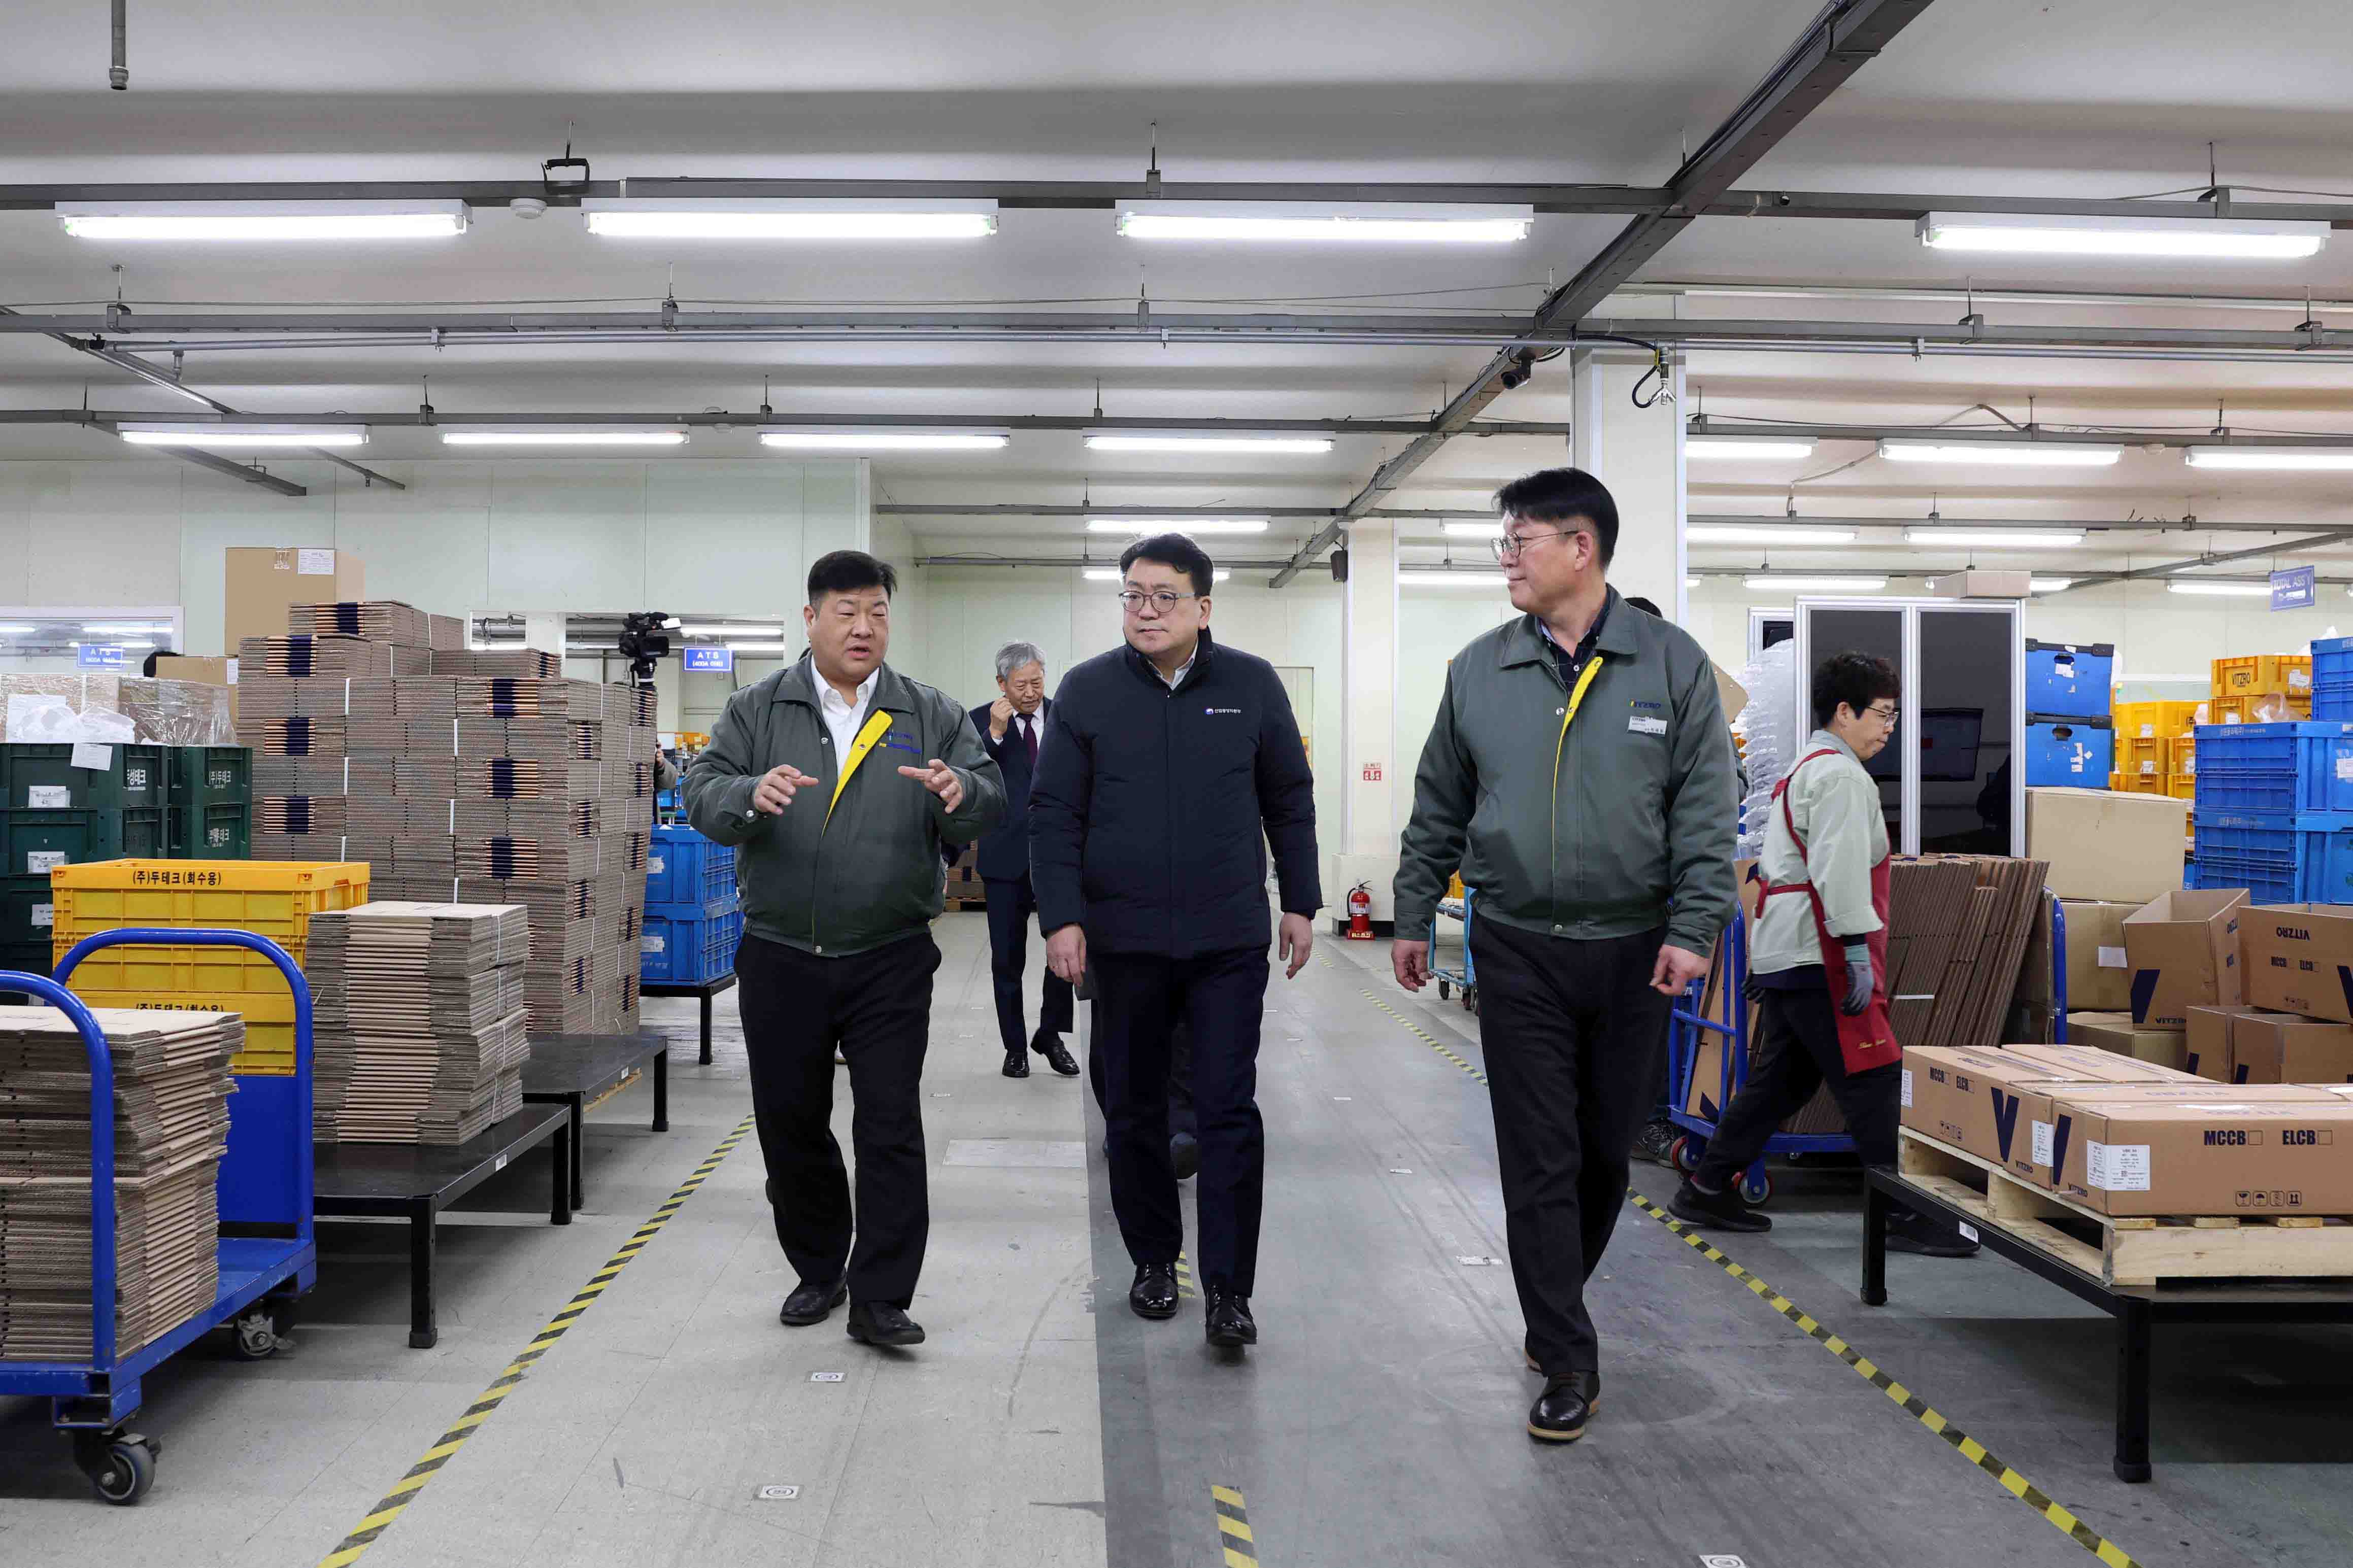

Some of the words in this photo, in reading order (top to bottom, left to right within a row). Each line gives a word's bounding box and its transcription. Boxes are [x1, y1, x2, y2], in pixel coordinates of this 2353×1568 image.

[2276, 926, 2310, 940] VITZRO
[1929, 1066, 1945, 1083] MCCB
[1956, 1075, 1969, 1091] ELCB
[2203, 1130, 2246, 1145] MCCB
[2282, 1130, 2316, 1145] ELCB
